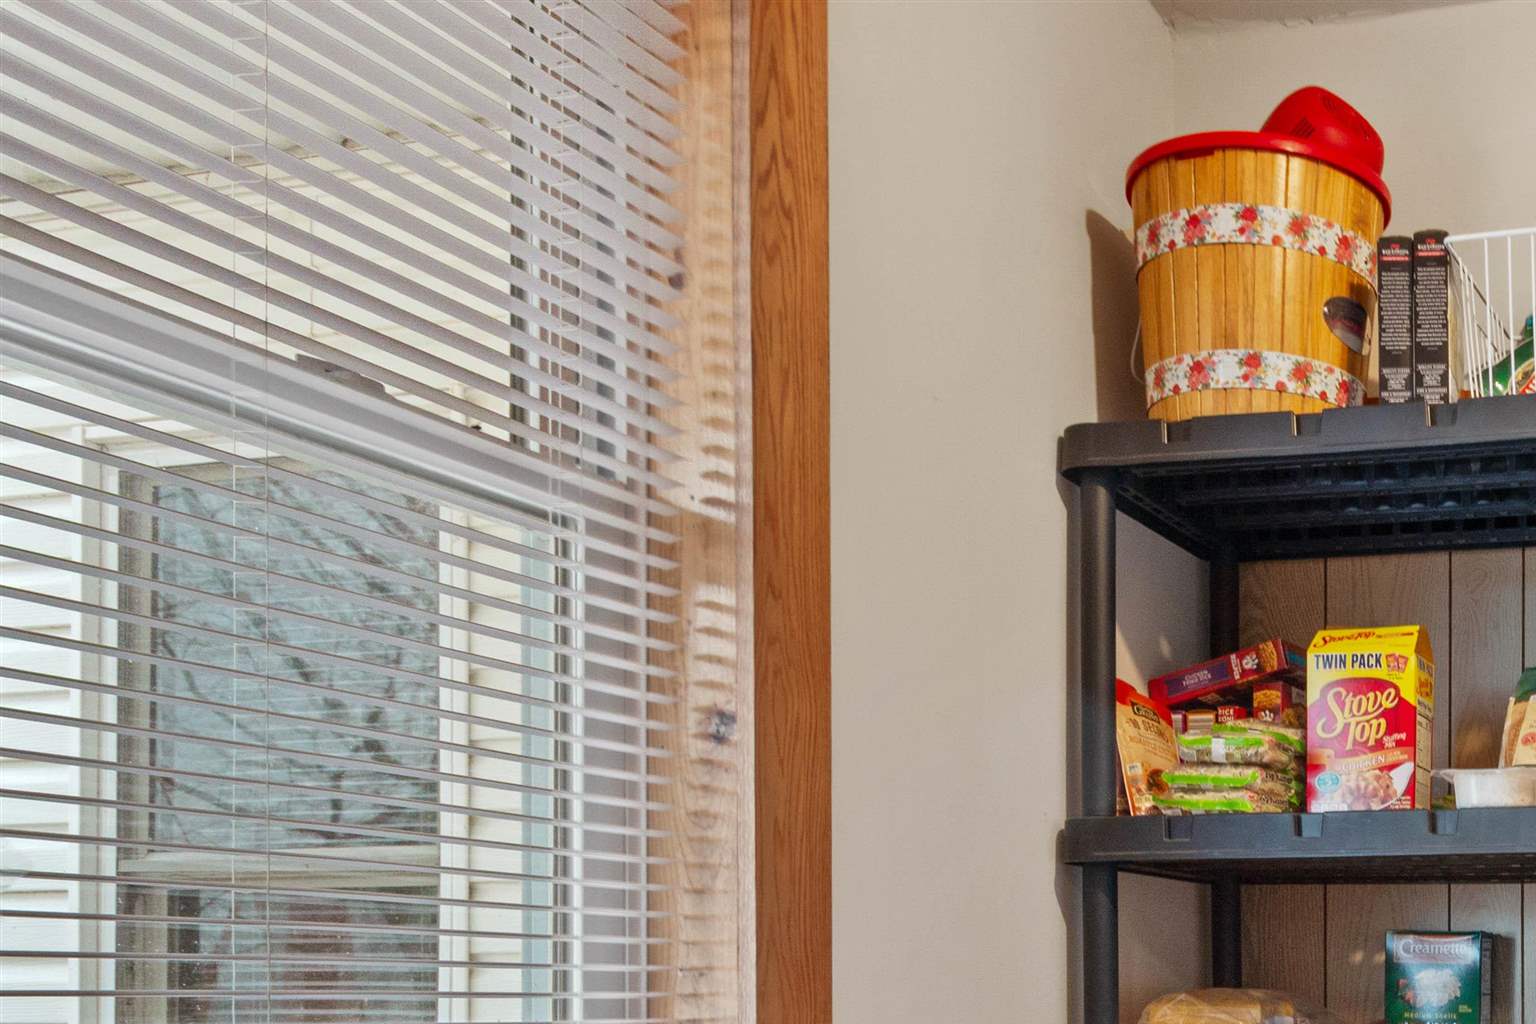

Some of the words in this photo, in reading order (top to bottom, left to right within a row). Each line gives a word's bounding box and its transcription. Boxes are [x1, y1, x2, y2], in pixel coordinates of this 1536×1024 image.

[1314, 654, 1347, 670] TWIN
[1351, 652, 1383, 669] PACK
[1316, 687, 1400, 739] Stove
[1345, 716, 1387, 751] Top
